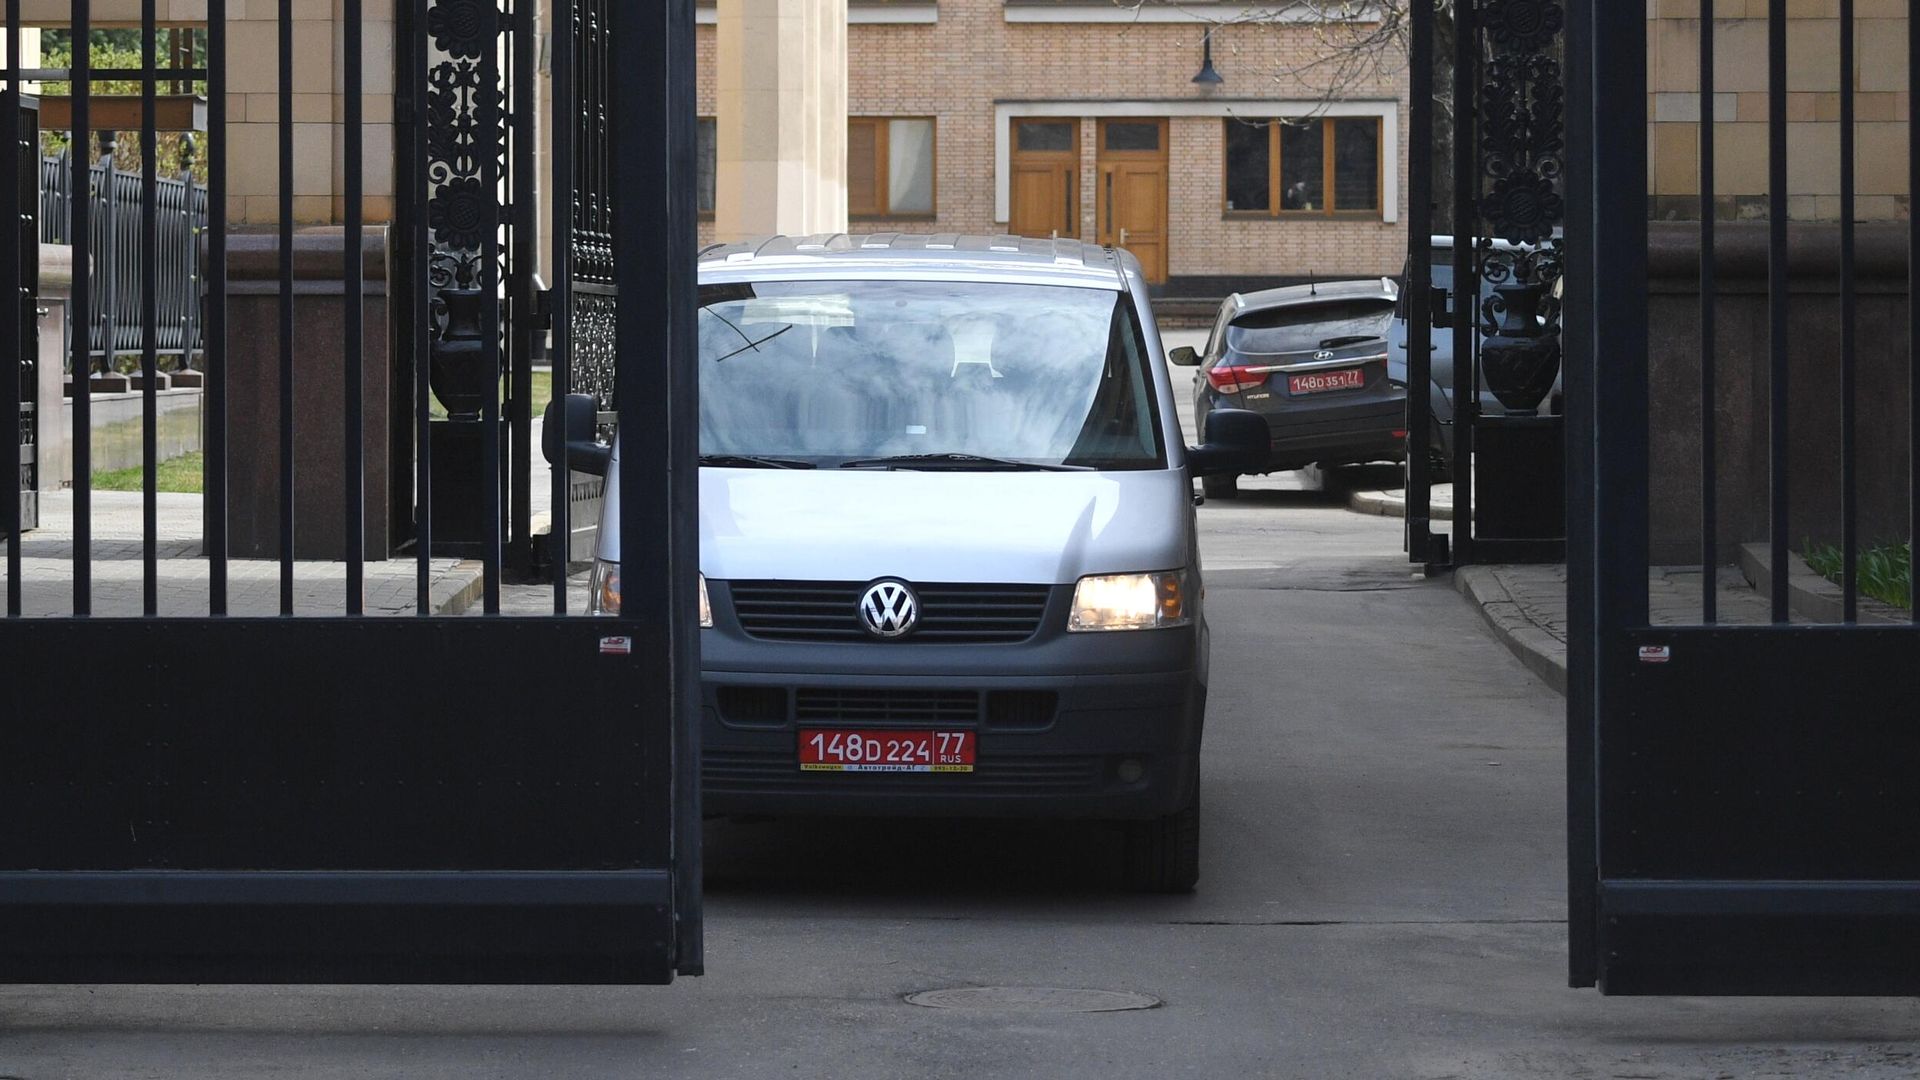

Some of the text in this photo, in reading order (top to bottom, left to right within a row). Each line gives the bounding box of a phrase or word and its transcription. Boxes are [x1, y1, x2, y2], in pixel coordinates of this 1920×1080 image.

[1346, 371, 1358, 384] 77
[886, 740, 929, 762] 224
[937, 733, 965, 754] 77
[940, 755, 962, 763] RUS
